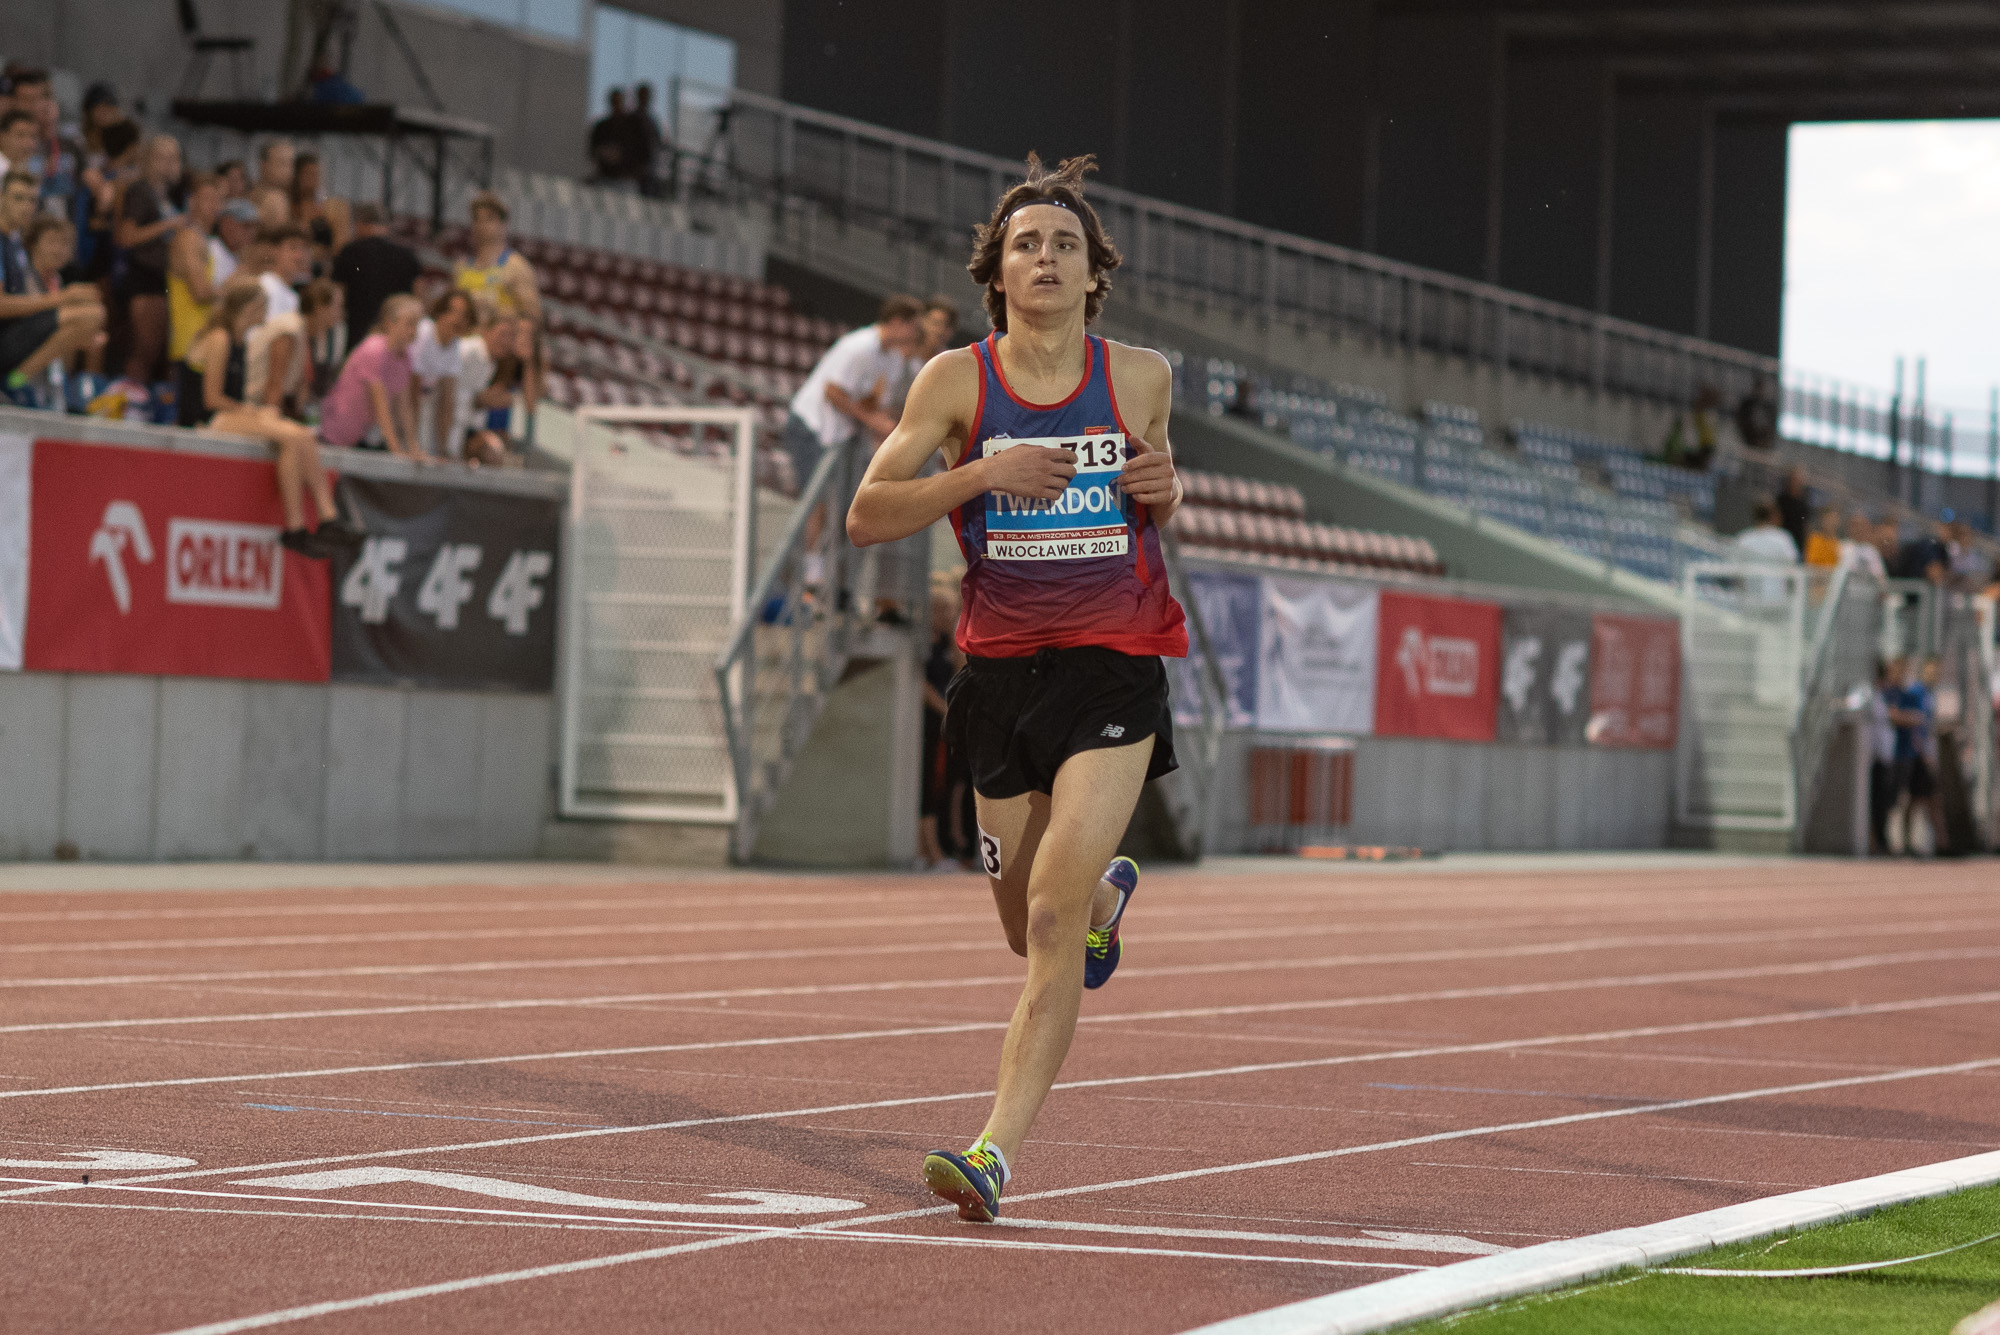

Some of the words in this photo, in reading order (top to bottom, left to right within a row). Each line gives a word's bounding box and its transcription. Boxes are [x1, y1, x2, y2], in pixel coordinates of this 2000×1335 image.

[1027, 531, 1081, 540] MISTRZOSTWA
[1082, 529, 1108, 538] POLSKI
[995, 543, 1086, 558] WŁOCŁAWEK
[1090, 540, 1120, 554] 2021
[176, 535, 276, 595] ORLEN
